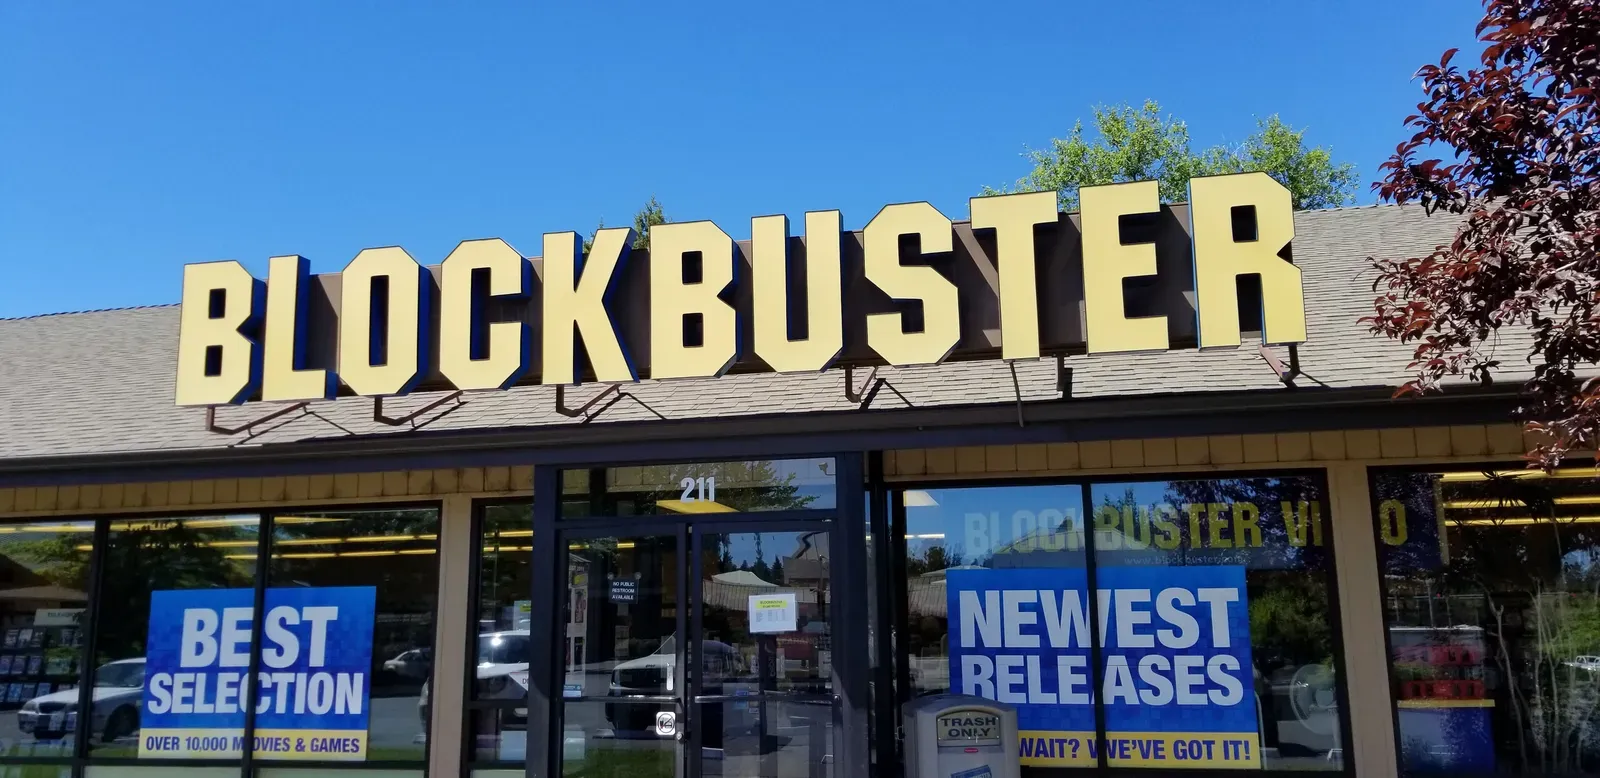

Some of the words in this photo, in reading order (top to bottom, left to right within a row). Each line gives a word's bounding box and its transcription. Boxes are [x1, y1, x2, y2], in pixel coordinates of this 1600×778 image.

[175, 171, 1307, 406] BLOCKBUSTER
[680, 477, 715, 503] 211
[964, 501, 1263, 556] BLOCKBUSTER
[180, 606, 338, 668] BEST
[959, 587, 1239, 649] NEWEST
[148, 672, 364, 714] SELECTION
[960, 654, 1244, 706] RELEASES
[940, 717, 997, 727] TRASH
[948, 727, 991, 738] ONLY
[146, 736, 180, 751] OVER
[185, 736, 228, 752] 10,000
[232, 737, 291, 752] MOVIES
[295, 738, 306, 752] &
[310, 738, 360, 753] GAMES
[1087, 739, 1166, 760] WE'VE
[1173, 740, 1216, 760] GOT
[1223, 740, 1251, 760] IT!
